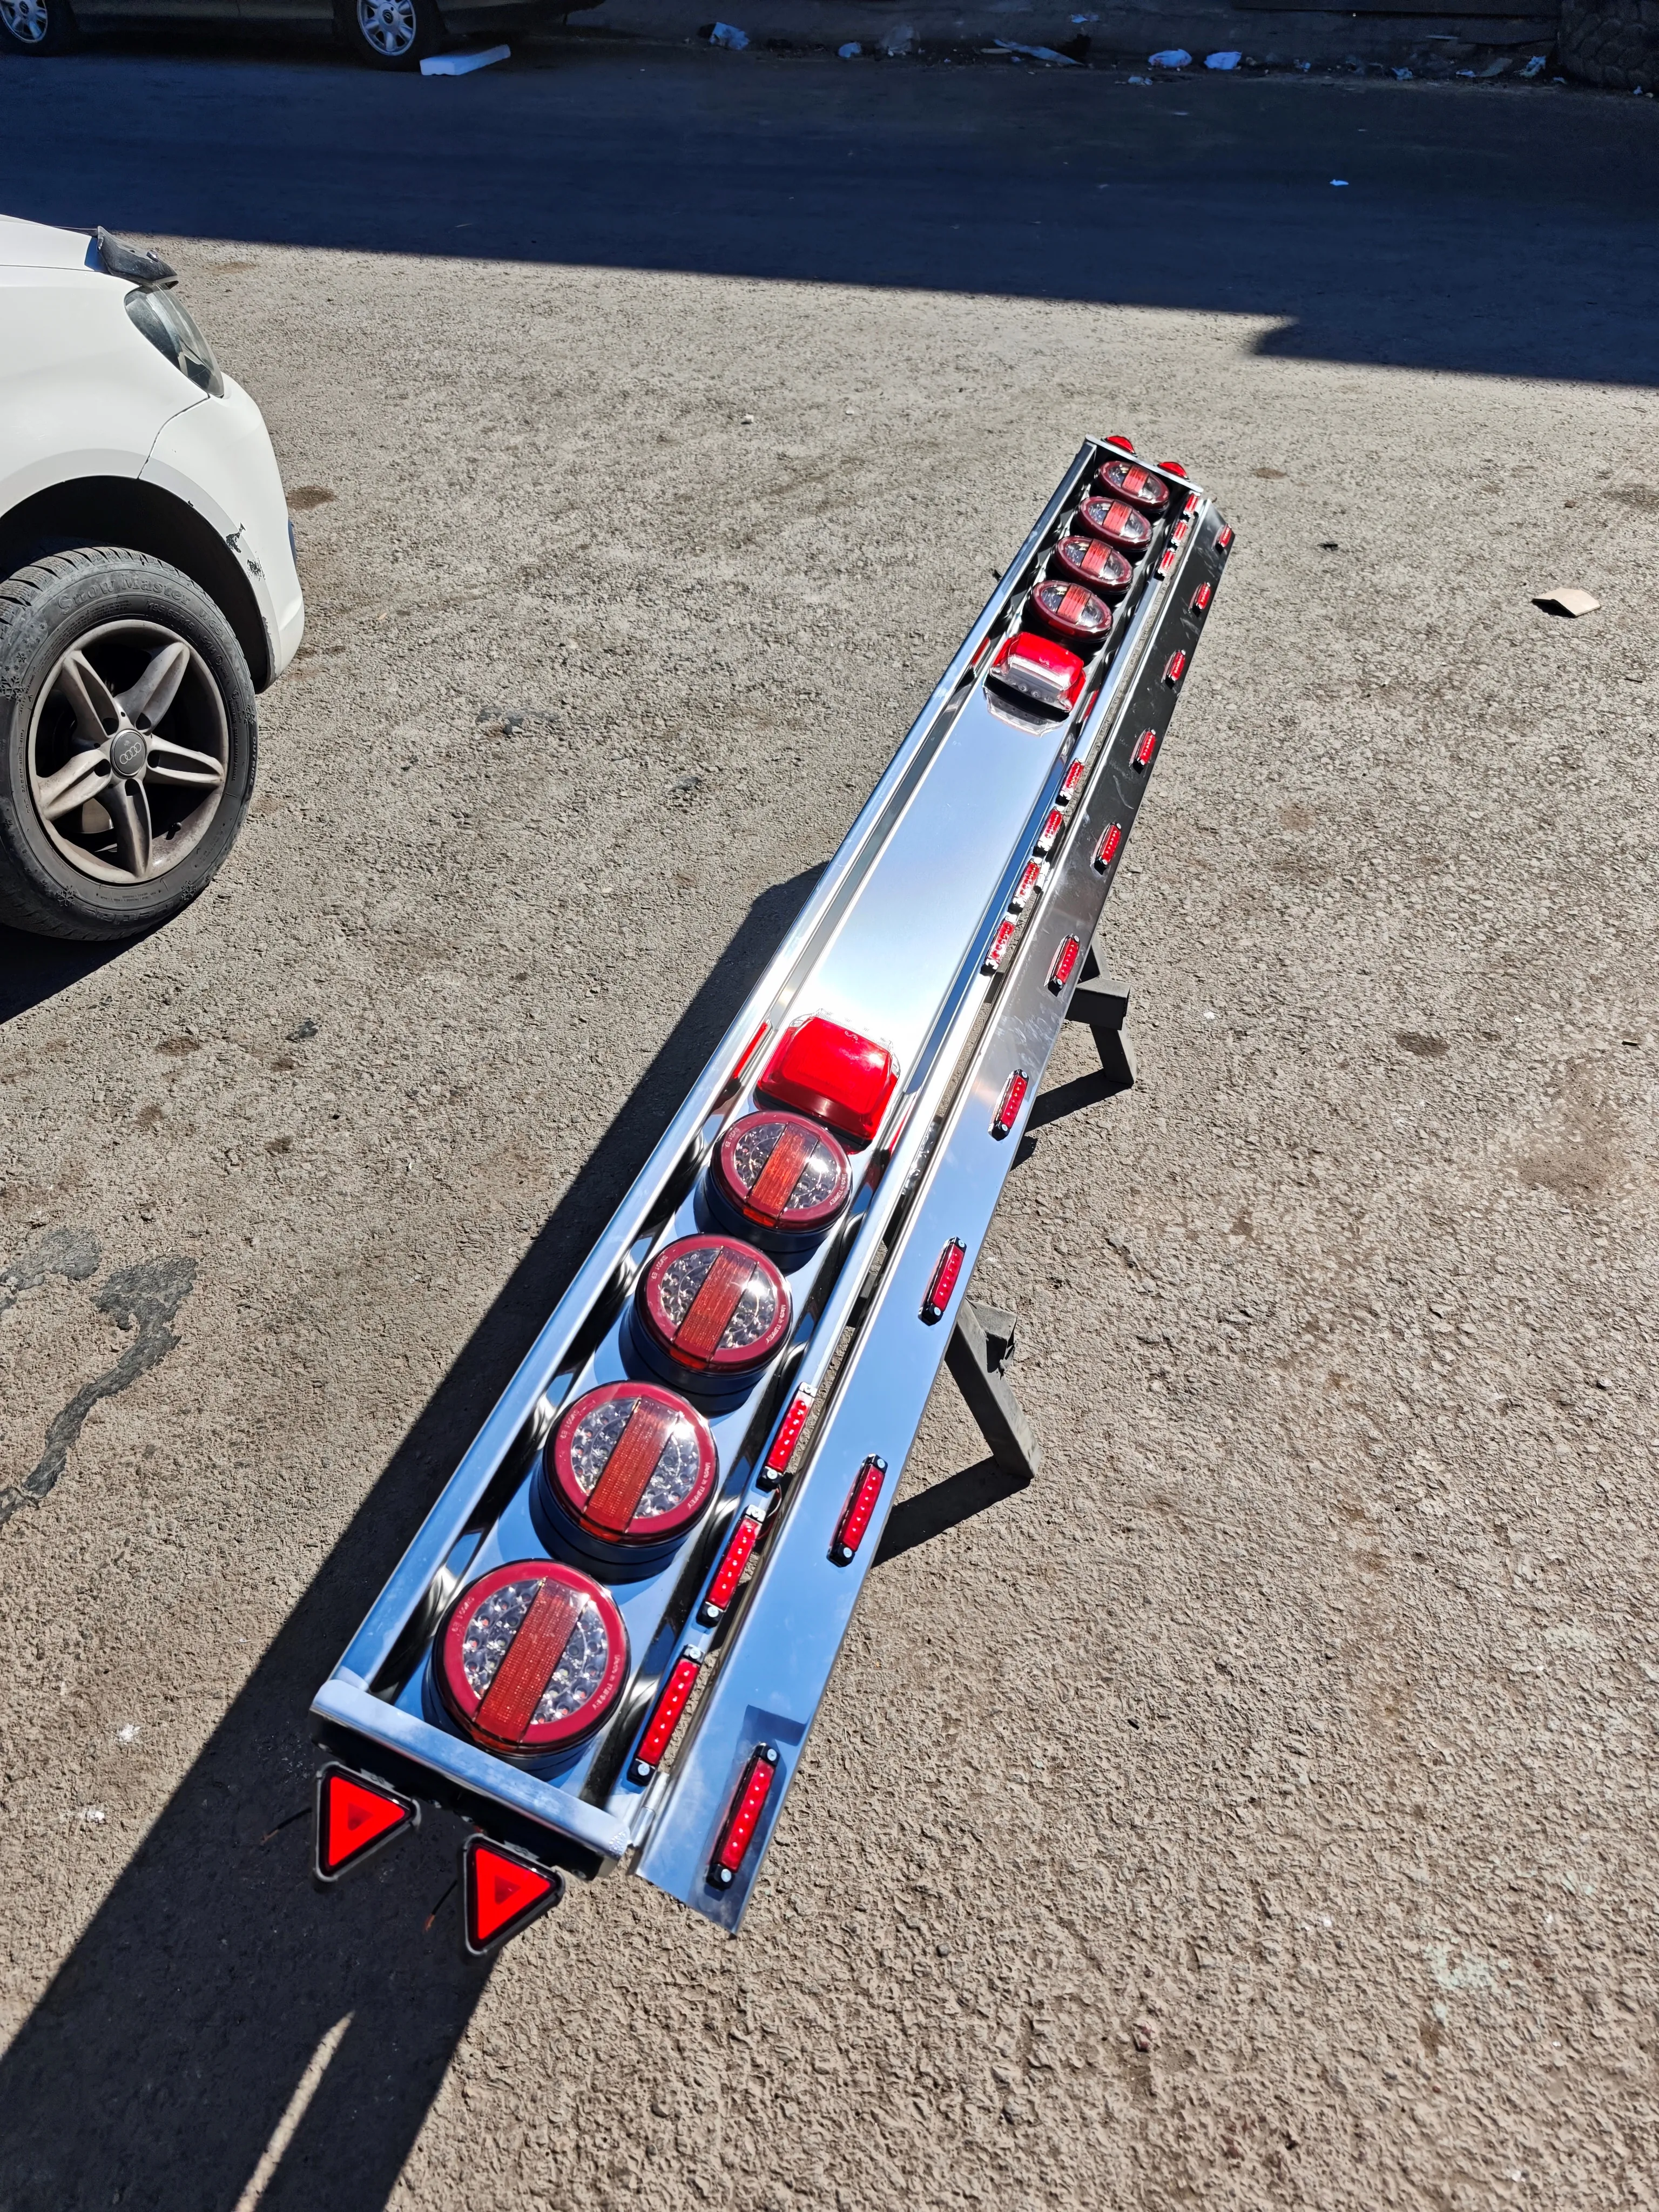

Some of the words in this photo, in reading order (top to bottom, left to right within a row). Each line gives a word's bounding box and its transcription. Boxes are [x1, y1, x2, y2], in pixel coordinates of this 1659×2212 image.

[57, 579, 115, 615] Snow
[121, 573, 191, 605] Master
[830, 1190, 843, 1206] TURKEY
[766, 1324, 782, 1344] TURKEY
[687, 1486, 705, 1509] TURKEY
